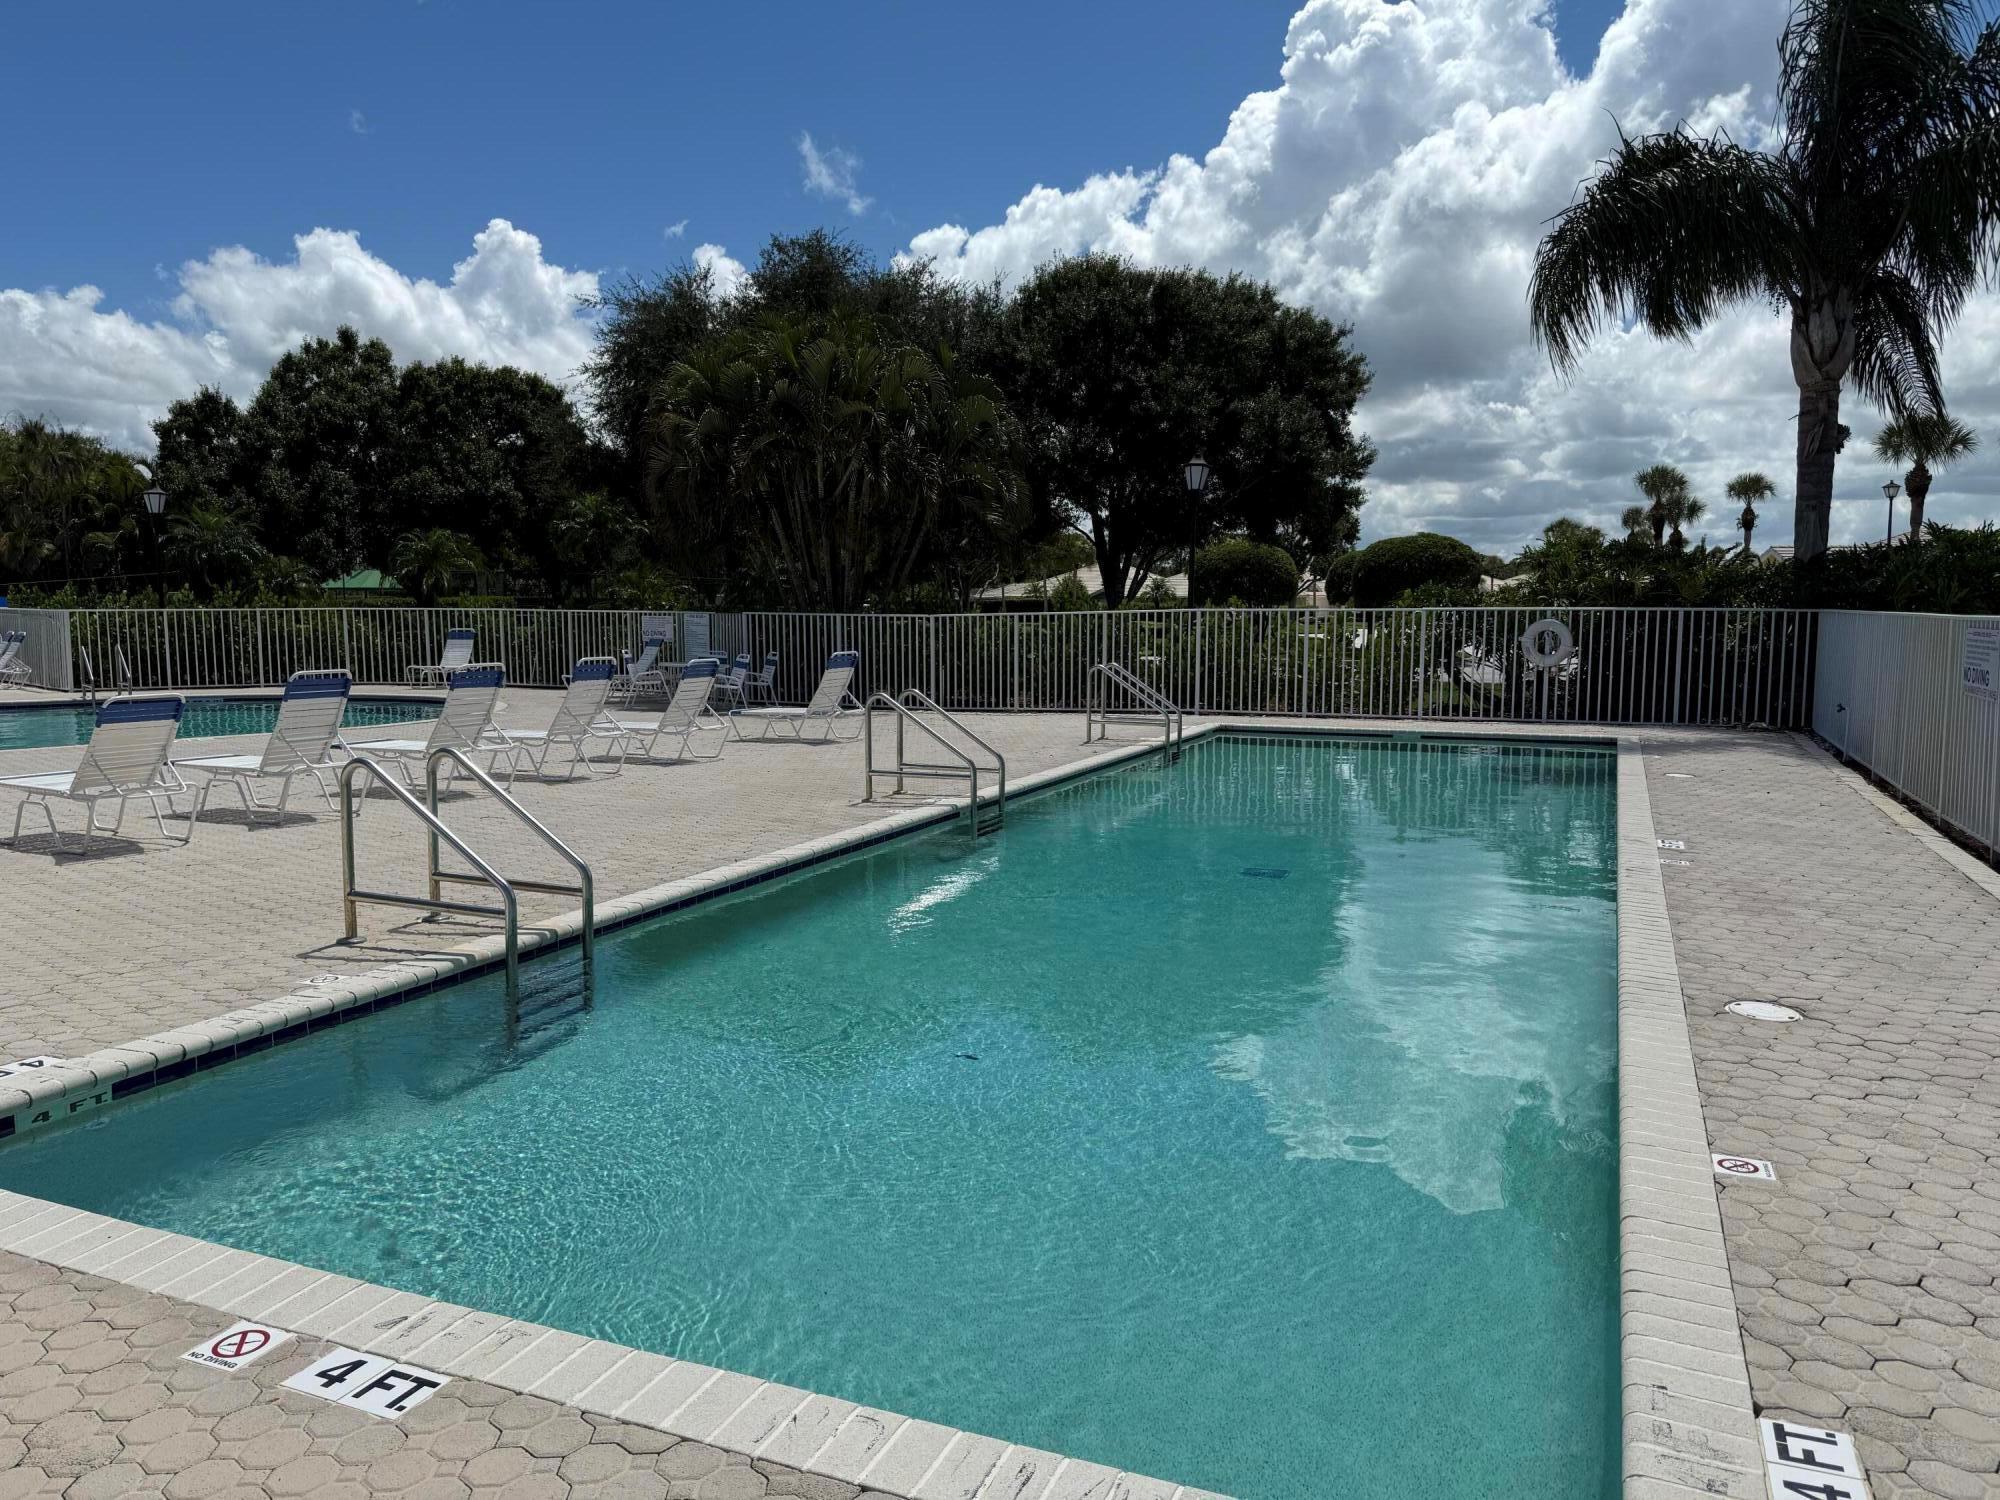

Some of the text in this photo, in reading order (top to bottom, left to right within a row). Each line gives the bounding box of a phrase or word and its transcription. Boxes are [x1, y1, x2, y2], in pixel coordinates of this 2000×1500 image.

[31, 1110, 52, 1124] 4
[188, 1351, 238, 1369] NO DIVING
[314, 1359, 369, 1388] 4
